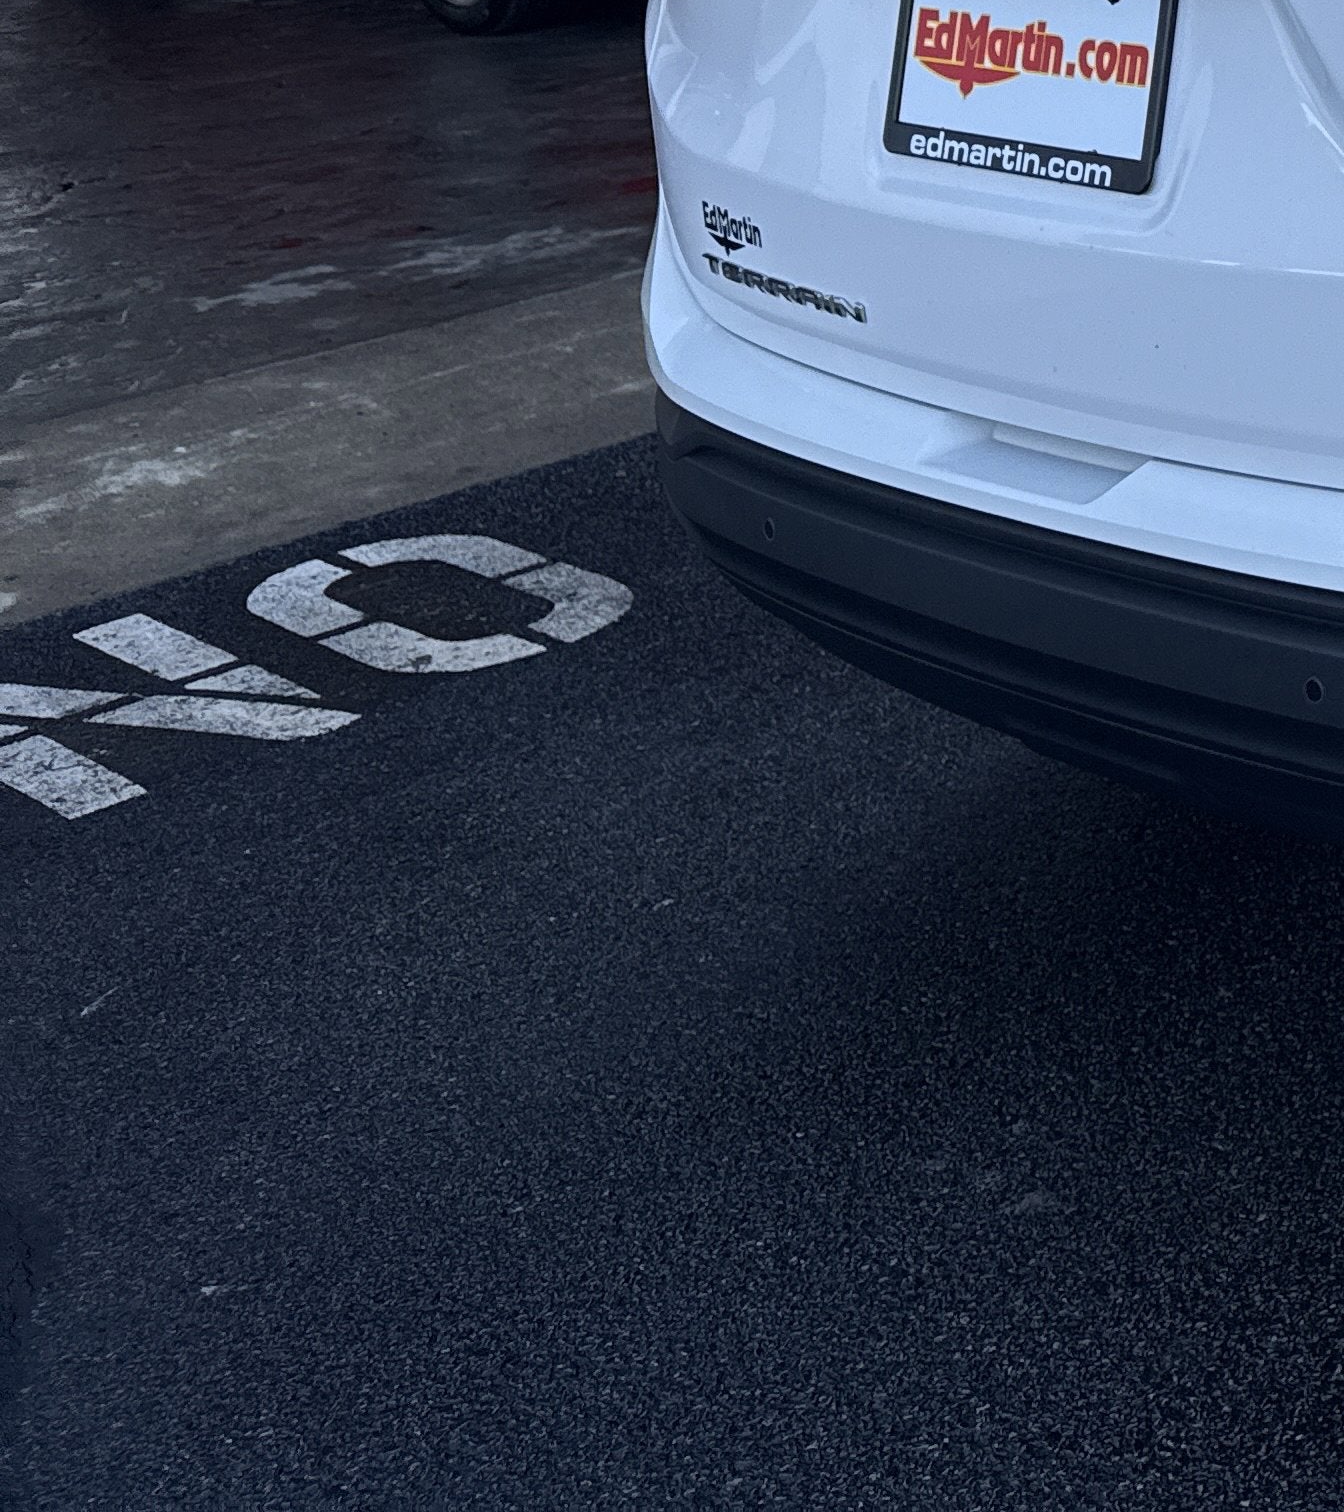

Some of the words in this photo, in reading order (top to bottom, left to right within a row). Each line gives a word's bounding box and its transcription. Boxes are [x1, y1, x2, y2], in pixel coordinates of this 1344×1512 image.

[914, 7, 1149, 88] EdMartin.com
[910, 131, 1112, 187] edmartin.com
[702, 200, 763, 249] EdMartin
[702, 252, 868, 324] TERRAIN
[0, 534, 634, 820] NO
